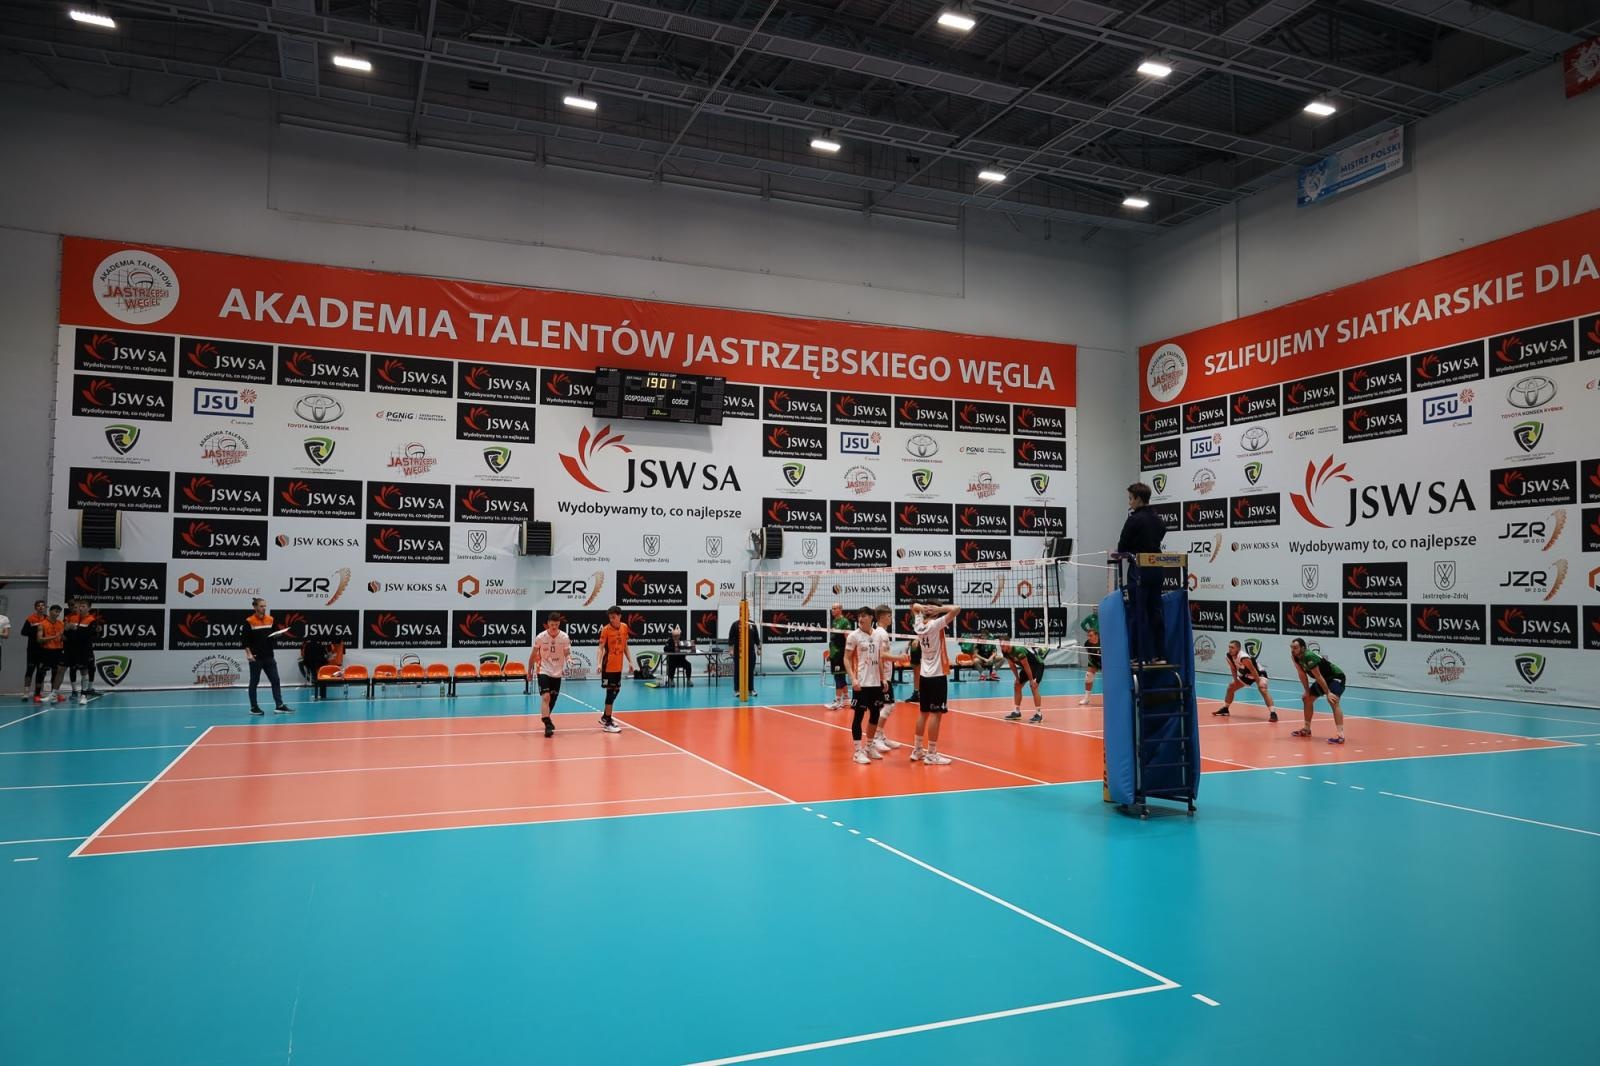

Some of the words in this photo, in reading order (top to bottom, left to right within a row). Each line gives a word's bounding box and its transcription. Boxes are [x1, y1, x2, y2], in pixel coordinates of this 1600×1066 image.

[1340, 155, 1369, 173] MISTRZ
[1370, 142, 1401, 160] POLSKI
[100, 259, 135, 281] AKADEMIA
[1204, 324, 1330, 376] SZLIFUJEMY
[1336, 271, 1524, 344] SIATKARSKIE
[1535, 253, 1600, 294] DIA
[218, 287, 457, 341] AKADEMIA
[469, 312, 675, 360] TALENTÓW
[683, 333, 951, 382] JASTRZĘBSKIEGO
[959, 358, 1056, 393] WĘGLA
[113, 346, 146, 361] JSW
[147, 349, 166, 363] SA
[1520, 340, 1548, 359] JSW
[1549, 337, 1566, 351] SA
[215, 355, 246, 369] JSW
[247, 358, 265, 371] SA
[1437, 358, 1462, 376] JSW
[1462, 356, 1477, 369] SA
[311, 363, 341, 376] JSW
[342, 365, 358, 378] SA
[402, 370, 429, 384] JSW
[430, 373, 446, 385] SA
[488, 377, 514, 390] JSW
[515, 379, 529, 391] SA
[111, 391, 144, 406] JSW
[145, 394, 164, 407] SA
[201, 394, 238, 411] JSU
[624, 394, 656, 403] GOSPODARZE
[671, 397, 689, 406] GOŚCIE
[787, 400, 809, 412] JSW
[809, 402, 821, 412] SA
[81, 407, 121, 415] Wydobywamy
[385, 411, 414, 420] PGNiG
[1428, 399, 1458, 418] JSU
[845, 437, 869, 450] JSU
[1194, 440, 1212, 454] JSU
[623, 458, 697, 493] JSW
[702, 464, 741, 492] SA
[1522, 479, 1551, 495] JSW
[1552, 478, 1569, 491] SA
[210, 488, 242, 502] JSW
[243, 489, 261, 502] SA
[307, 492, 336, 506] JSW
[337, 494, 354, 506] SA
[399, 496, 426, 509] JSW
[427, 497, 443, 509] SA
[1345, 481, 1421, 527] JSW
[1428, 479, 1476, 515] SA
[557, 500, 649, 520] Wydobywamy
[652, 503, 666, 519] to,
[669, 507, 684, 518] co
[685, 504, 742, 522] najlepsze
[853, 512, 873, 523] JSW
[874, 513, 886, 523] SA
[1498, 521, 1546, 539] JZR
[209, 533, 241, 547] JSW
[242, 534, 259, 546] SA
[293, 537, 314, 547] JSW
[316, 537, 345, 547] KOKS
[347, 538, 360, 547] SA
[398, 538, 426, 552] JSW
[427, 539, 443, 551] SA
[1187, 541, 1212, 553] JZR
[1240, 543, 1253, 551] JSW
[1253, 542, 1270, 550] KOKS
[1271, 542, 1279, 550] SA
[1288, 539, 1370, 556] Wydobywamy
[1372, 537, 1388, 551] to,
[1392, 538, 1407, 549] co
[1410, 534, 1477, 550] najlepsze
[908, 550, 922, 558] JSW
[923, 550, 943, 558] KOKS
[943, 550, 952, 558] SA
[211, 577, 233, 586] JSW
[280, 577, 330, 593] JZR
[485, 579, 503, 587] JSW
[1240, 579, 1253, 587] JSW
[1253, 578, 1270, 586] KOKS
[1271, 578, 1279, 586] SA
[1366, 575, 1387, 588] JSW
[1388, 575, 1401, 587] SA
[1500, 570, 1548, 587] JZR
[211, 587, 261, 596] INNOWACJE
[384, 582, 405, 593] JSW
[406, 582, 433, 592] KOKS
[435, 583, 448, 592] SA
[485, 588, 528, 596] INNOWACJE
[545, 580, 587, 594] JZR
[643, 583, 666, 595] JSW
[667, 583, 680, 594] SA
[719, 582, 736, 590] JSW
[768, 581, 805, 595] JZR
[844, 585, 860, 593] JSW
[860, 585, 880, 593] KOKS
[881, 585, 891, 593] SA
[962, 582, 993, 594] JZR
[1422, 592, 1469, 601] Jastrzębie-Zdrój
[1303, 614, 1322, 626] JSW
[1322, 615, 1334, 626] SA
[1438, 617, 1463, 631] JSW
[1464, 618, 1479, 631] SA
[1522, 619, 1551, 634] JSW
[1552, 620, 1569, 633] SA
[482, 623, 508, 636] JSW
[509, 623, 525, 634] SA
